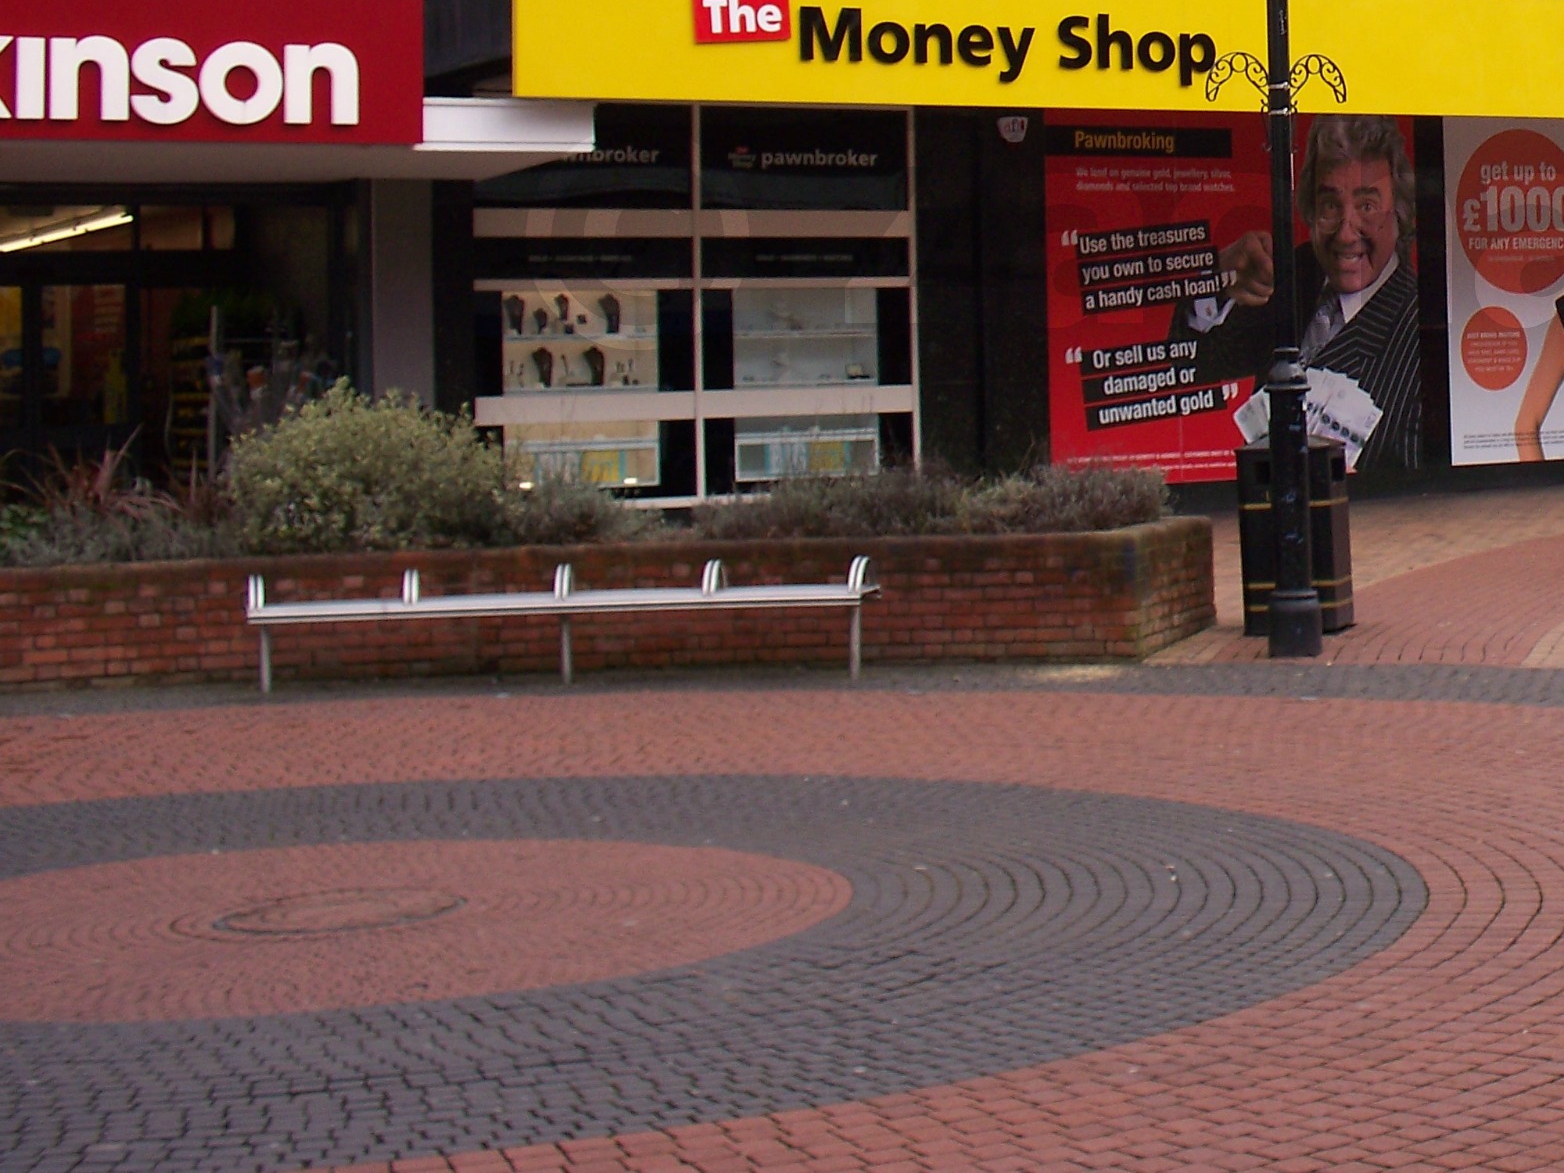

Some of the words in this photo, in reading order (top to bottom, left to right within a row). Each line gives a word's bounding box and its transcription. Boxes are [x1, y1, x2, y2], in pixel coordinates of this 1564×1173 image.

[799, 5, 1035, 84] Money
[1057, 13, 1217, 87] Shop
[0, 35, 360, 125] inson
[1074, 130, 1176, 154] Pawnbroking
[761, 150, 878, 169] pawnbroker
[1480, 161, 1508, 185] get
[1513, 165, 1535, 185] up
[1539, 162, 1556, 182] to
[1110, 233, 1135, 251] the
[1138, 226, 1206, 247] treasures
[1469, 237, 1488, 250] FOR
[1490, 237, 1510, 250] ANY
[1082, 265, 1110, 285] you
[1113, 261, 1144, 277] own
[1147, 256, 1162, 269] to
[1166, 251, 1214, 270] secure
[1085, 295, 1096, 309] a
[1099, 287, 1144, 308] handy
[1147, 281, 1181, 301] cash
[1092, 350, 1111, 369] Or
[1114, 345, 1143, 366] sell
[1146, 345, 1166, 361] us
[1169, 340, 1198, 359] any
[1103, 367, 1176, 395] damaged
[1179, 367, 1197, 384] or
[1098, 395, 1177, 425] unwanted
[1180, 389, 1214, 415] gold
